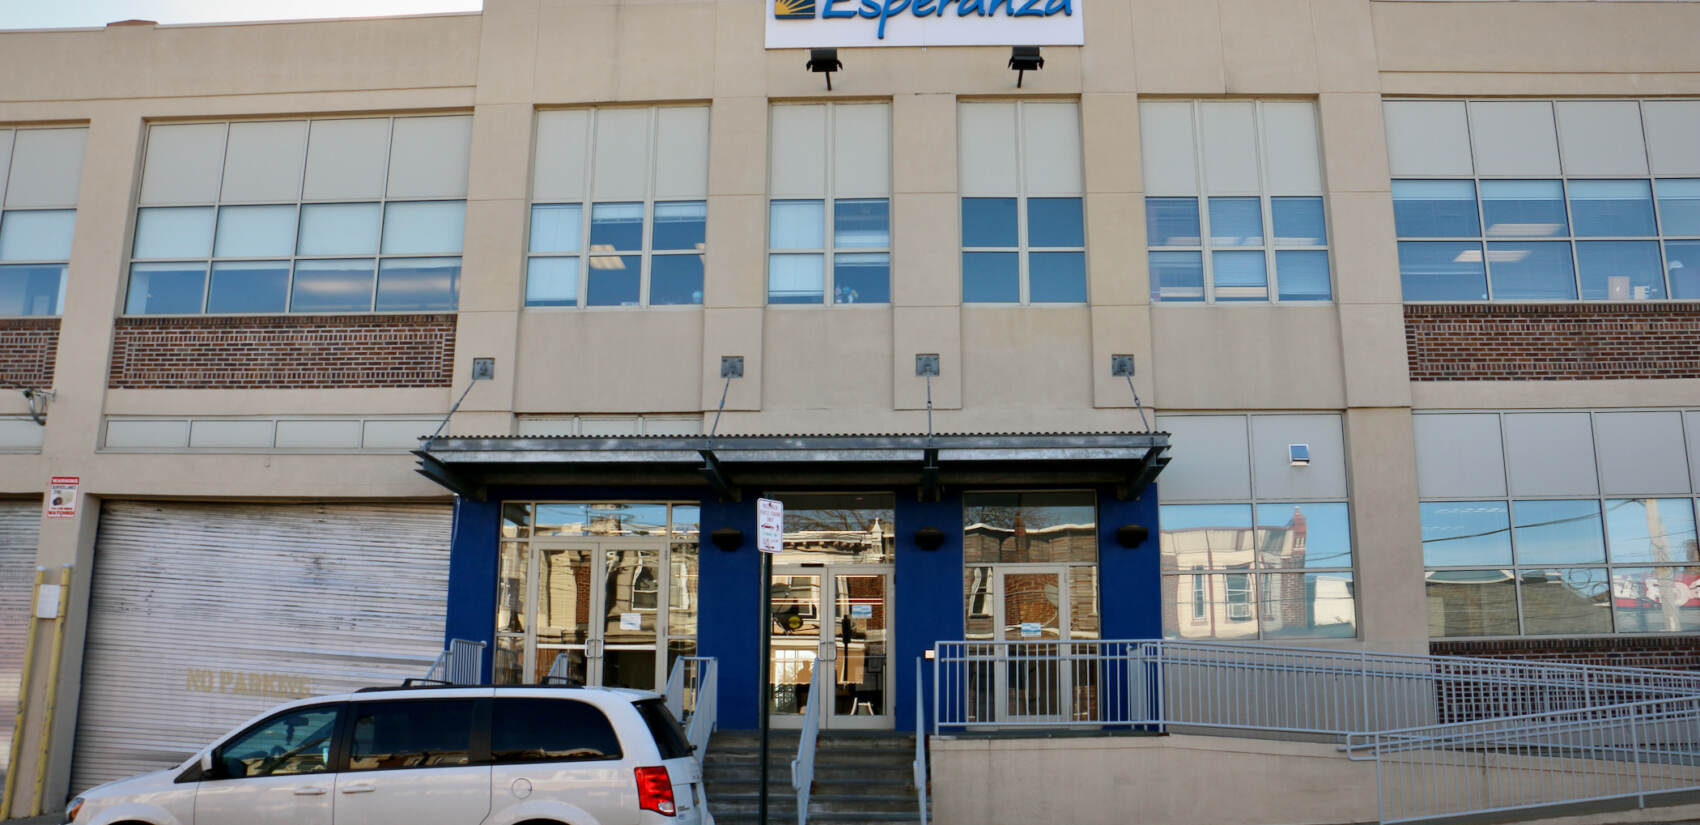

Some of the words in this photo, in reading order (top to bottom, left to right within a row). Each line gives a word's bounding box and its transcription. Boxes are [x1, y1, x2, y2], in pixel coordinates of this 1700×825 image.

[821, 0, 1073, 40] Esperanza
[186, 667, 214, 692] NO
[219, 670, 312, 698] PARKING
